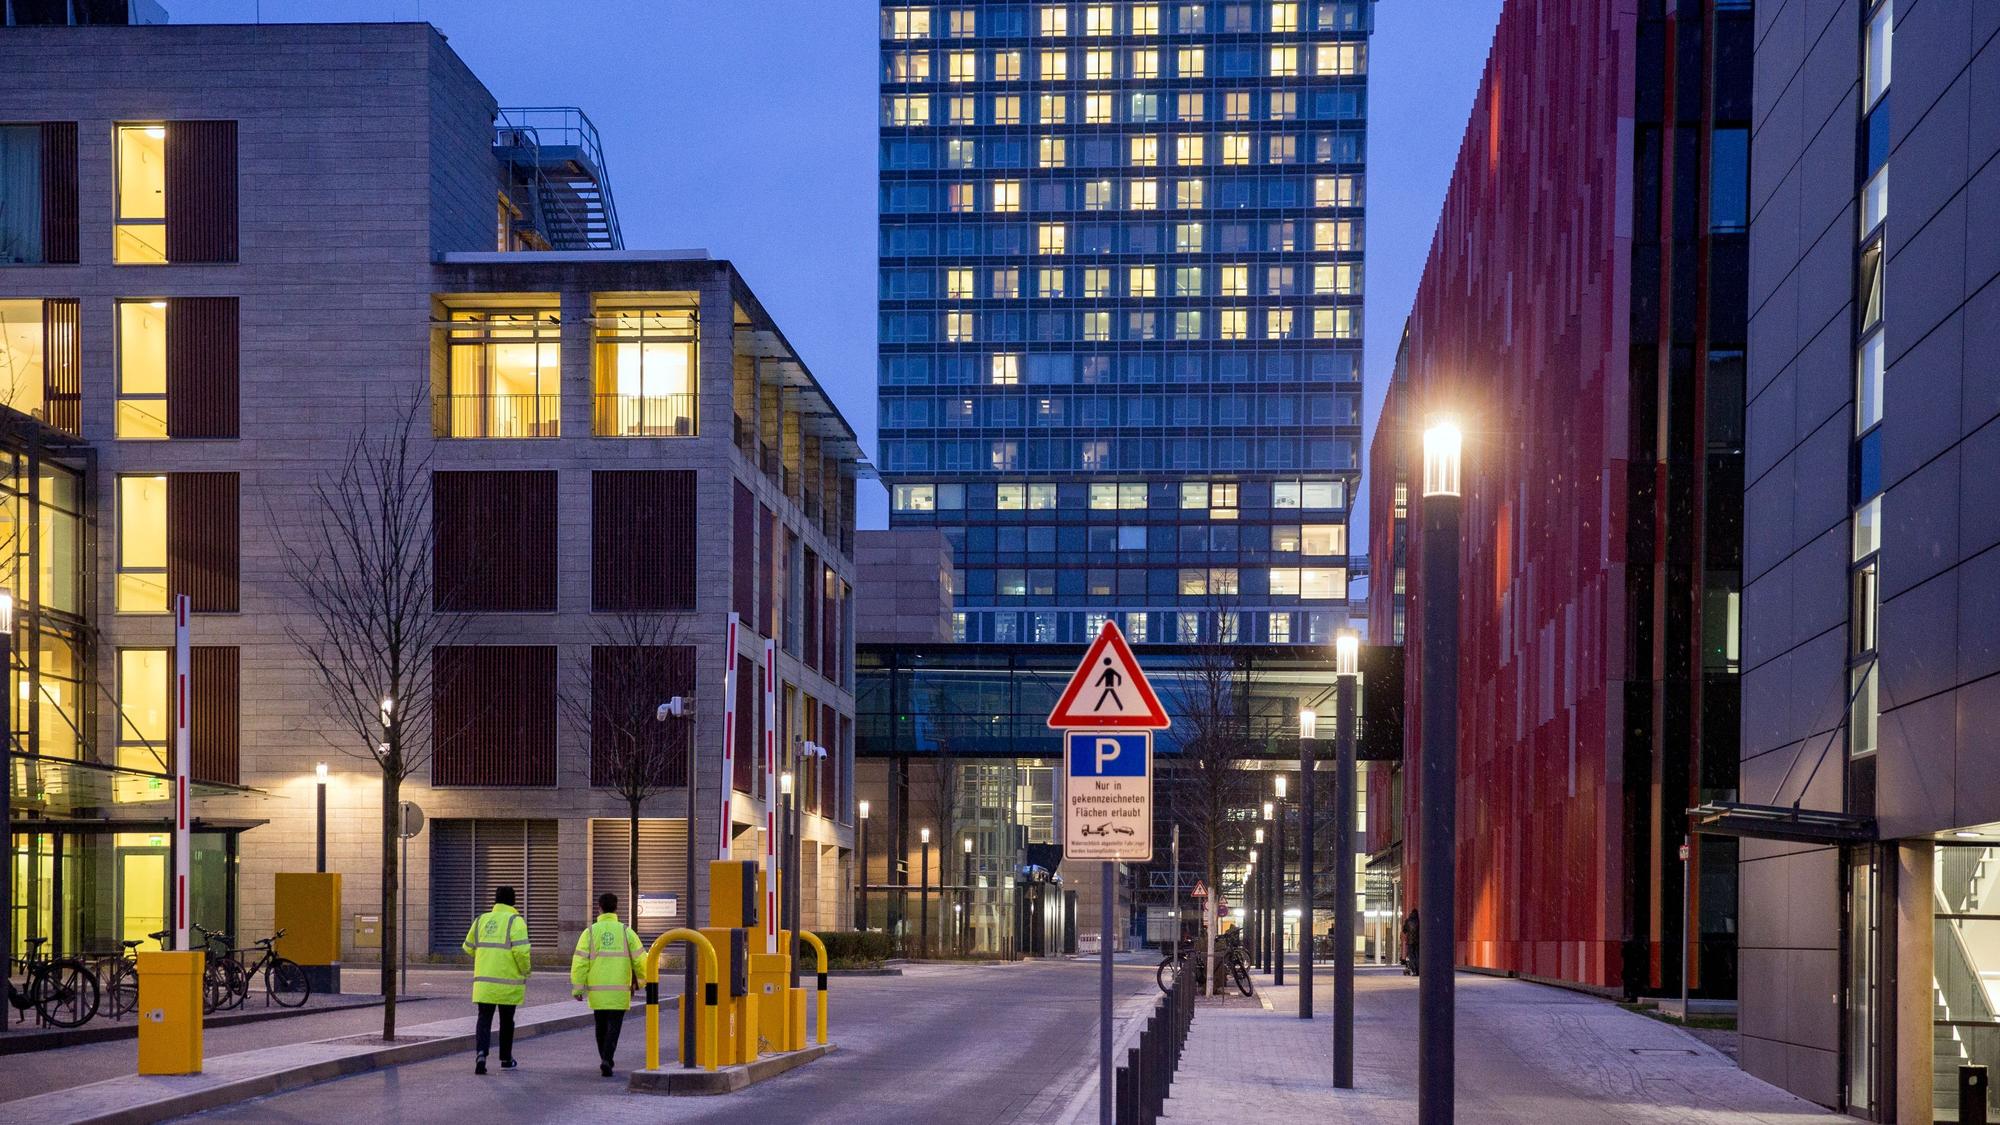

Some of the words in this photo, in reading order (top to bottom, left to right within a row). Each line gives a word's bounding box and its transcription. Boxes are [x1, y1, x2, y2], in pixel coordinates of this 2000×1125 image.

[1095, 738, 1121, 774] P
[1095, 781, 1109, 790] Nur
[1114, 781, 1122, 790] in
[1072, 794, 1145, 806] gekennzeichneten
[1075, 807, 1108, 817] Flächen
[1111, 807, 1141, 817] erlaubt
